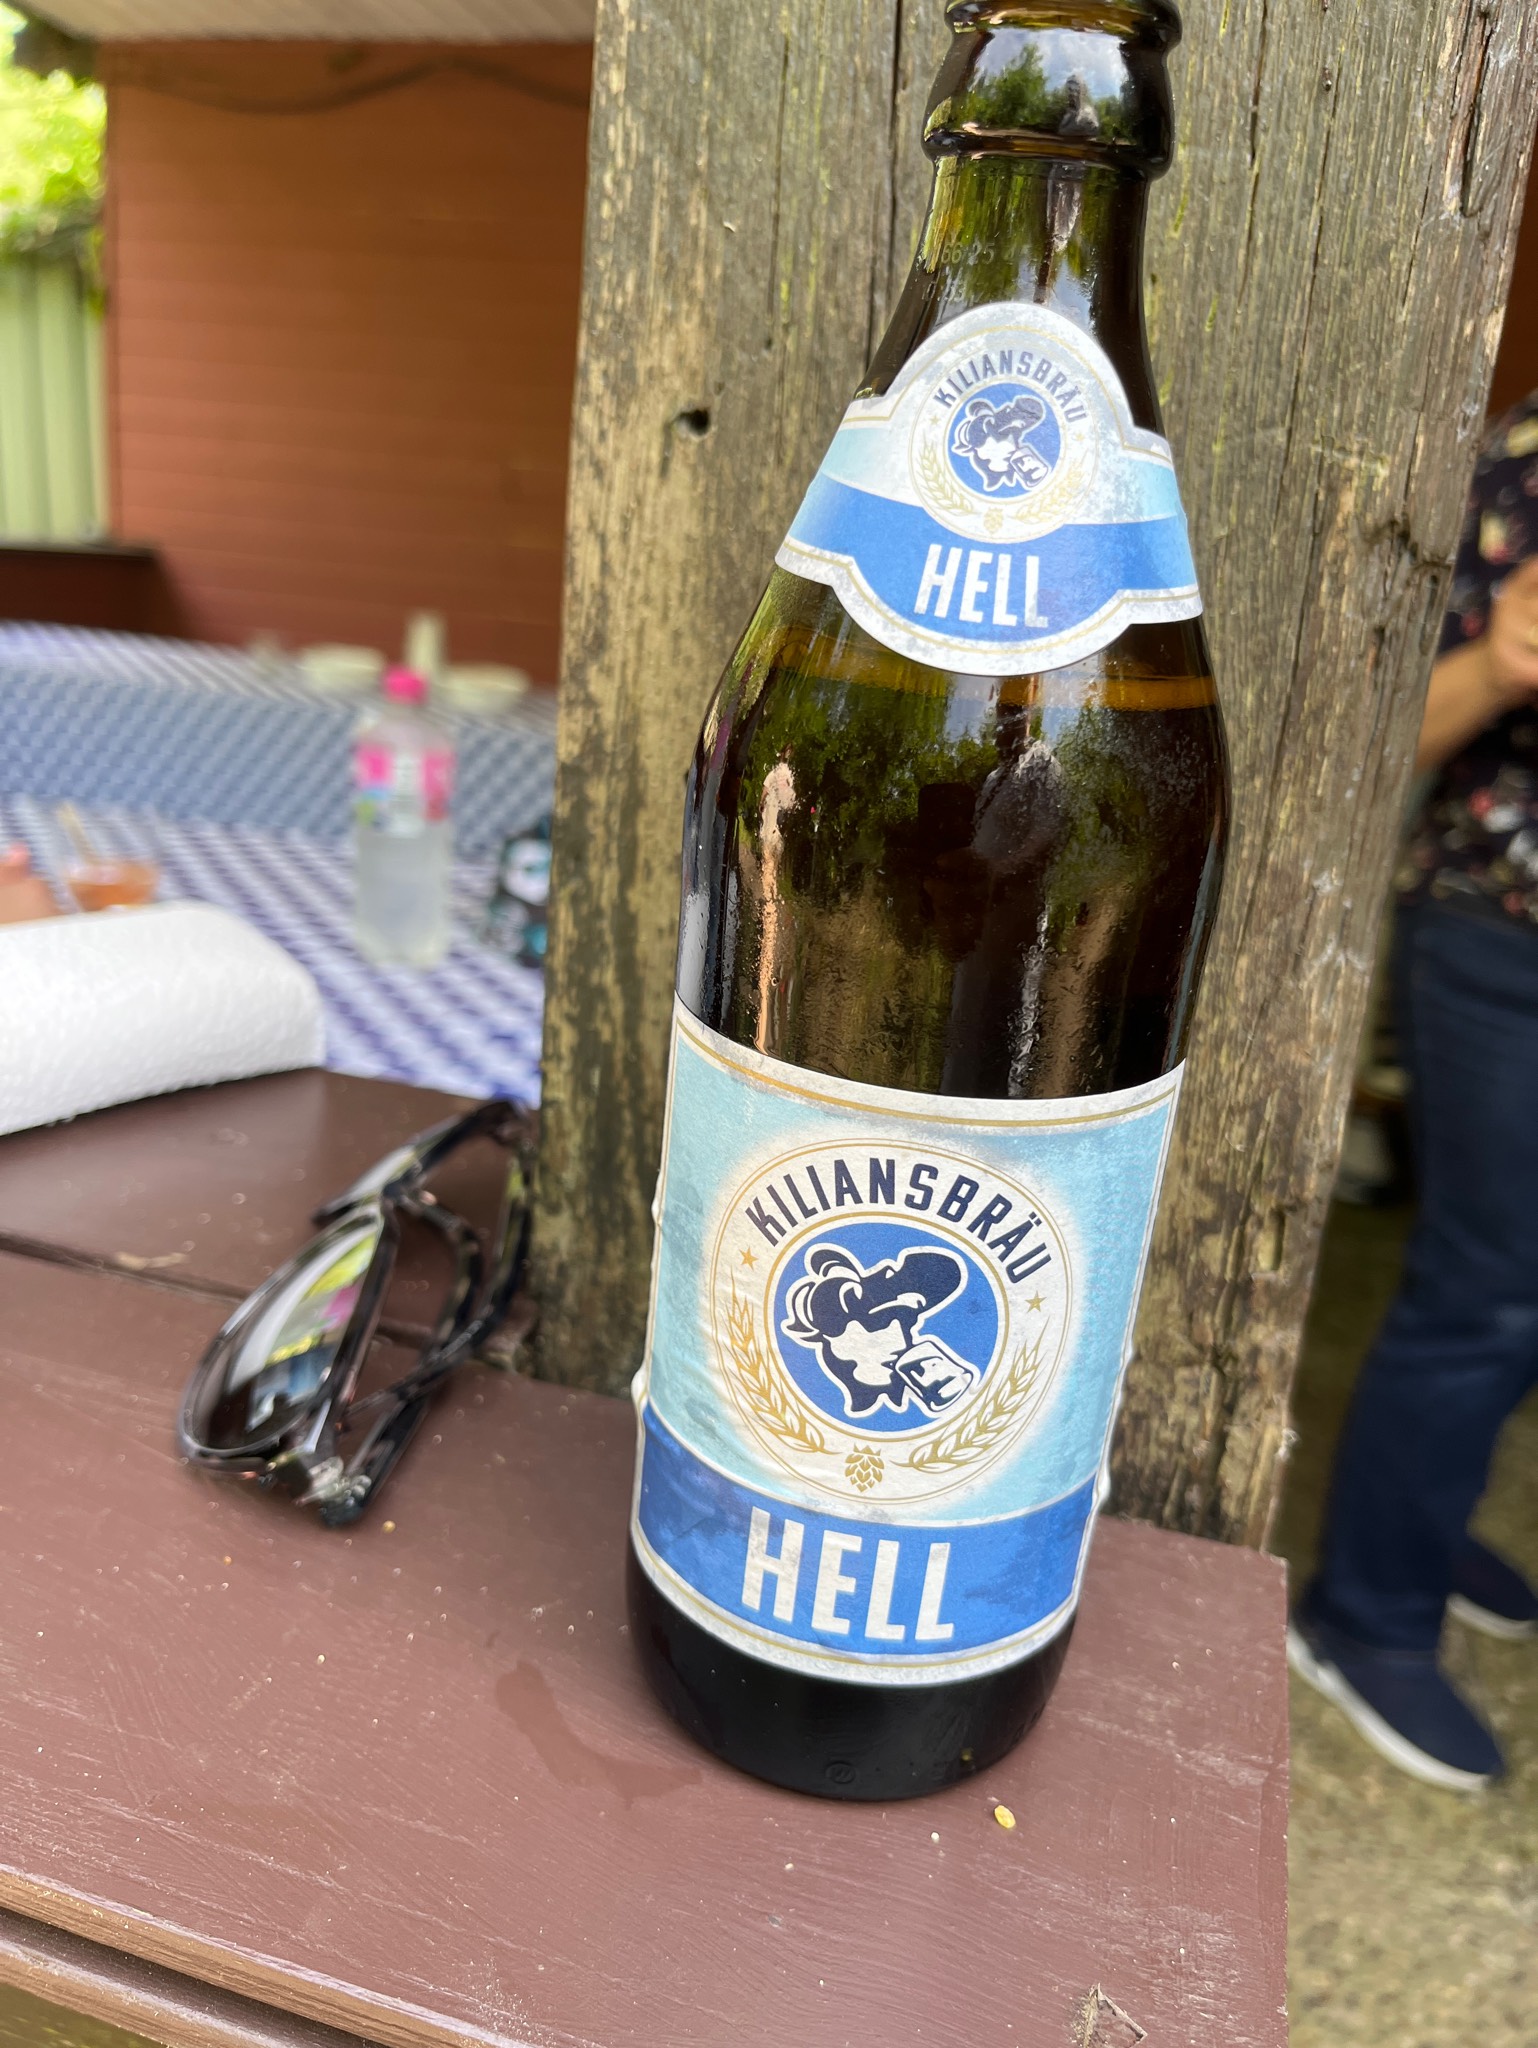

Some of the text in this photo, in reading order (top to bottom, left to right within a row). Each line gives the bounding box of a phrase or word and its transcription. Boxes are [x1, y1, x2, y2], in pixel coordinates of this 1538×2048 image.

[934, 350, 1087, 424] KILIANSBRÄU
[914, 544, 1048, 628] HELL
[745, 1157, 1052, 1284] KILIANSBRÄU
[741, 1506, 955, 1640] HELL
